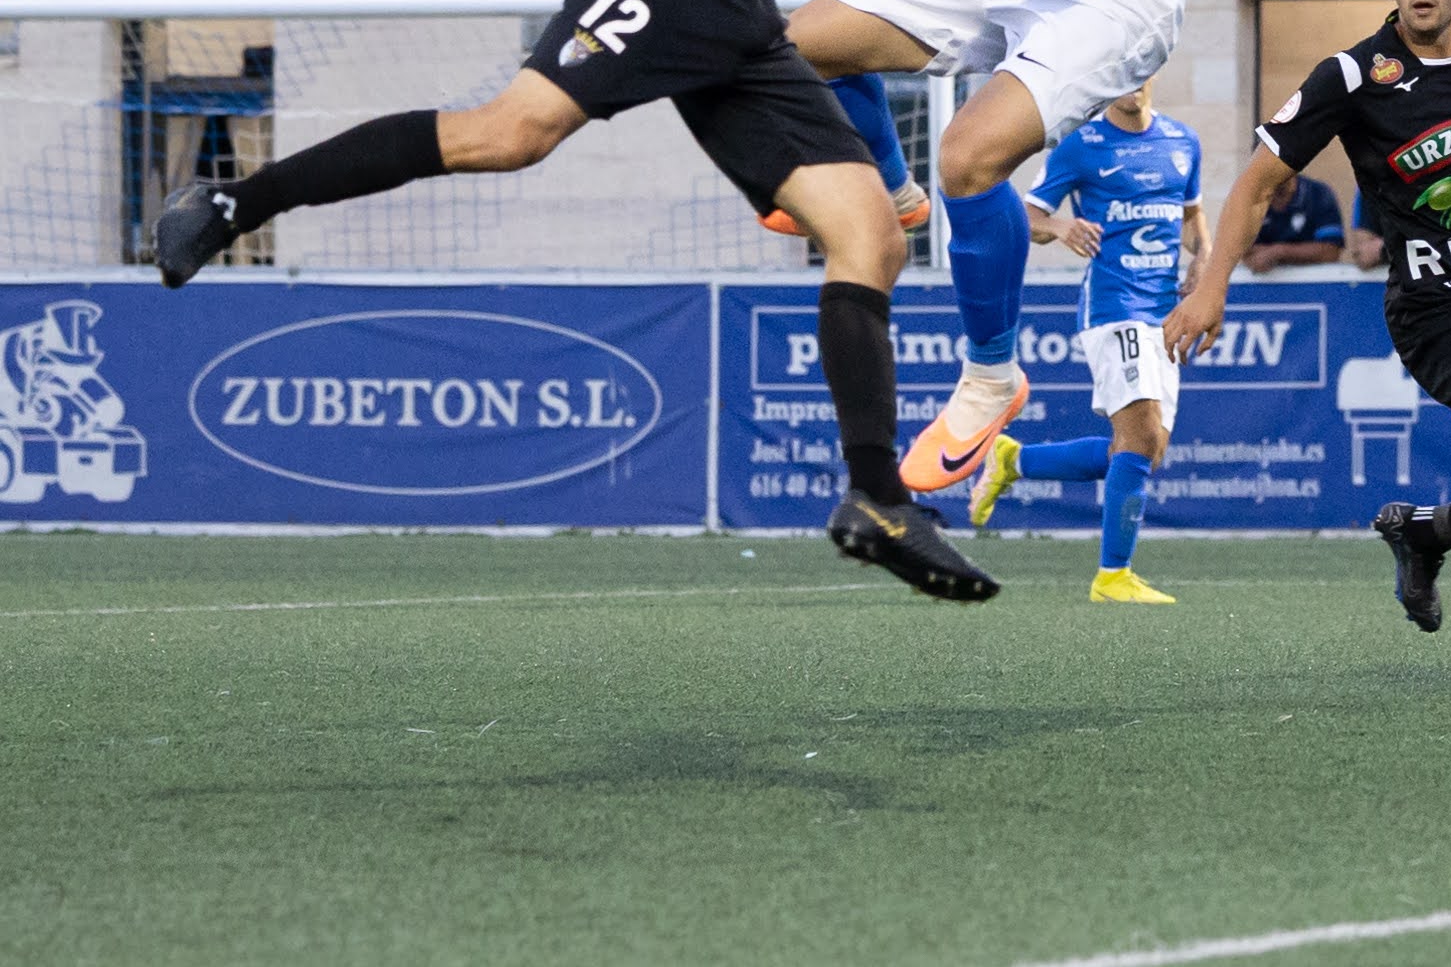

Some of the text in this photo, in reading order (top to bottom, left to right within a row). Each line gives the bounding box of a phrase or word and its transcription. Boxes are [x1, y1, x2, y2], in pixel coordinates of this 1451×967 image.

[1114, 328, 1140, 363] 18
[222, 377, 637, 429] ZUBETON S.L.
